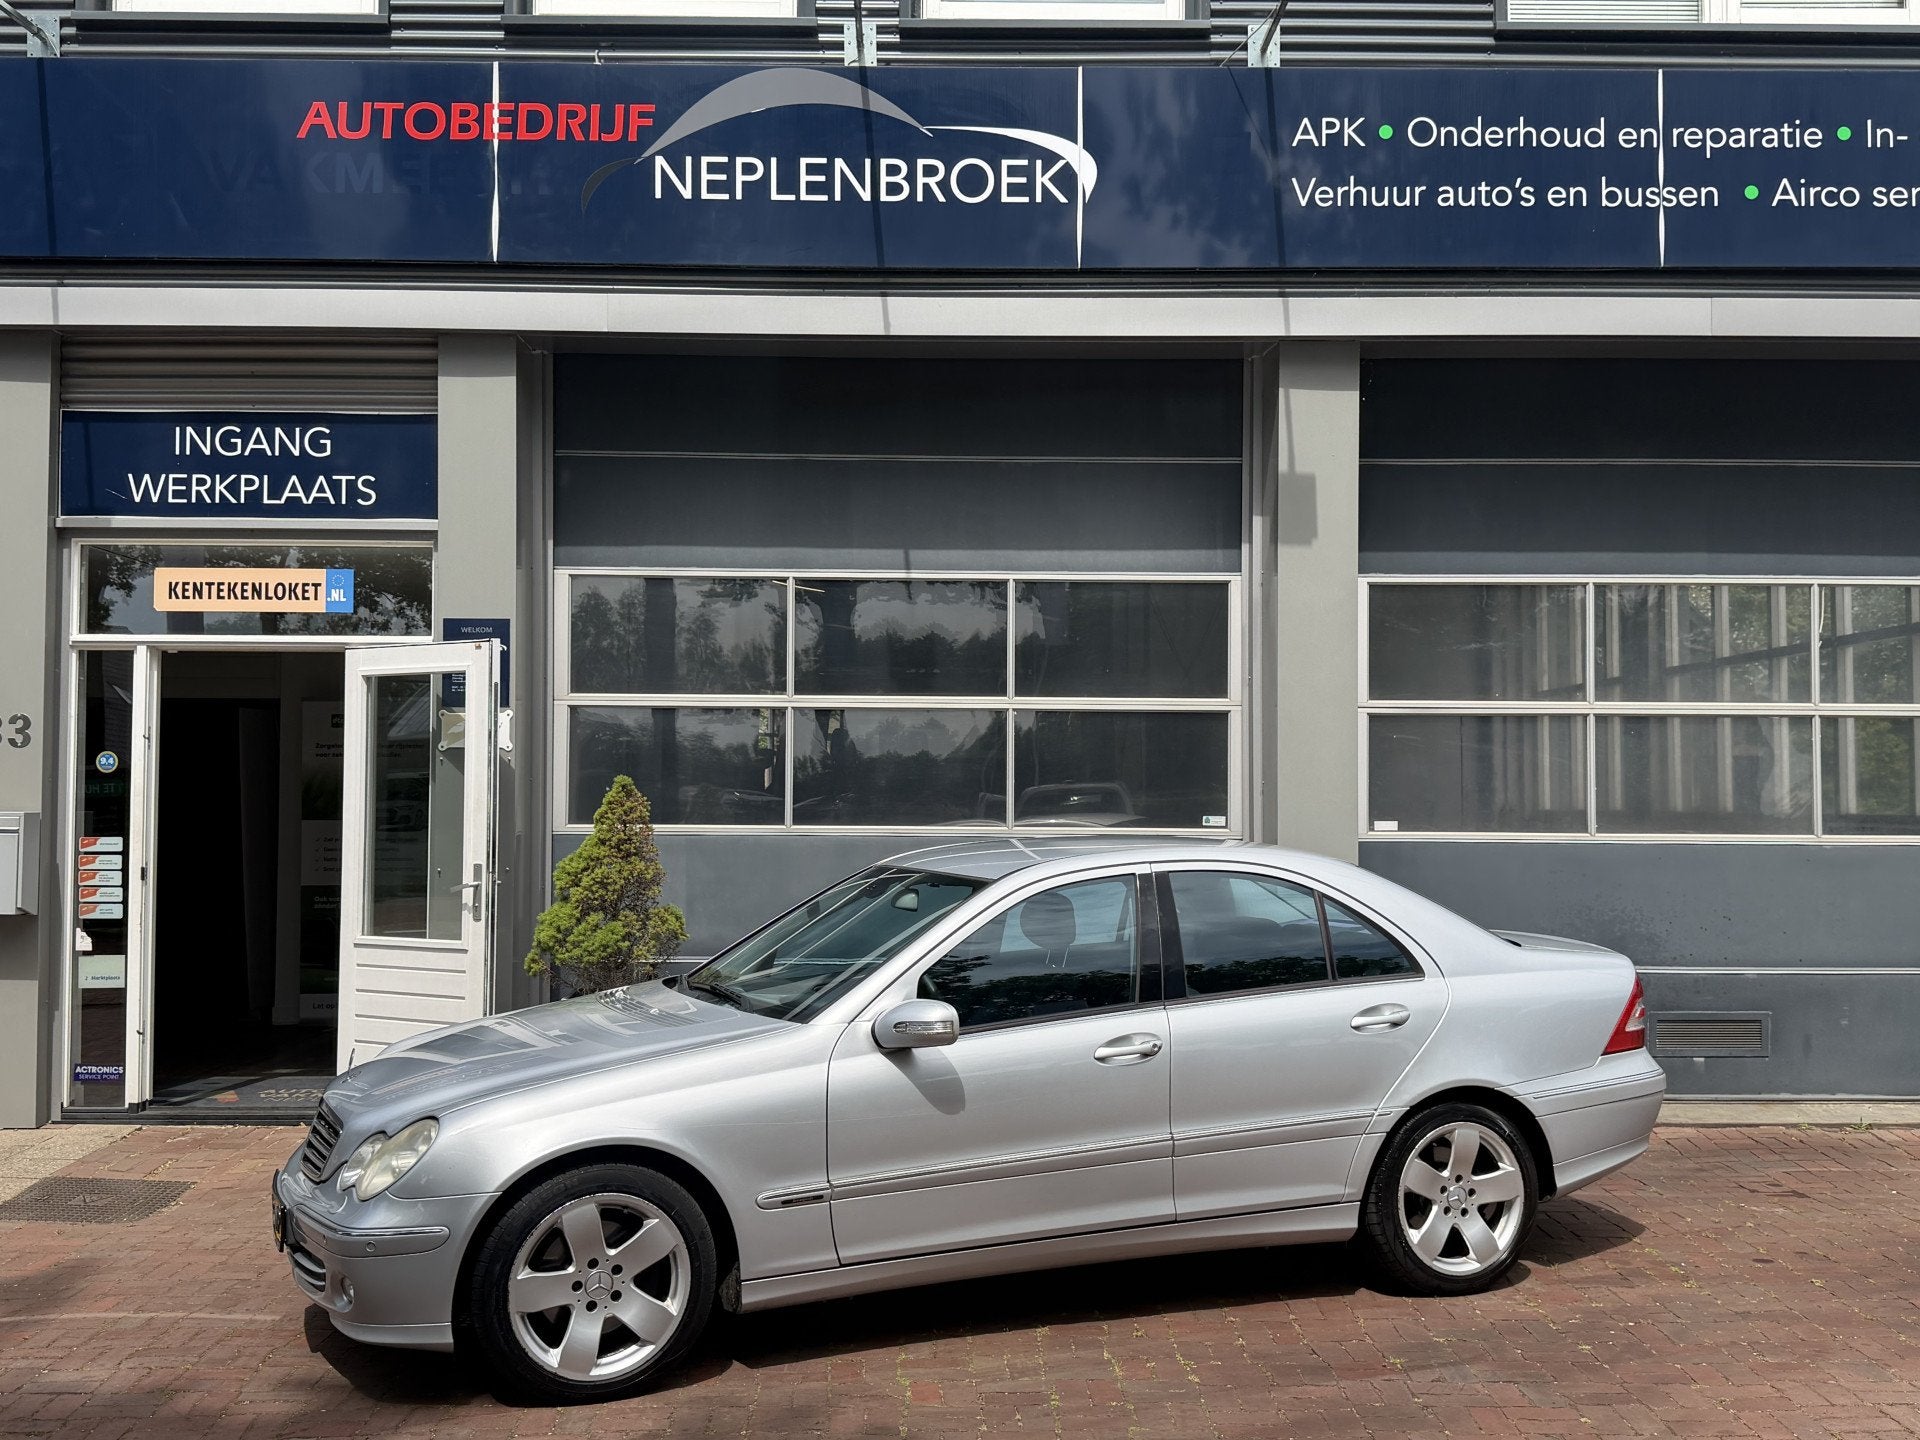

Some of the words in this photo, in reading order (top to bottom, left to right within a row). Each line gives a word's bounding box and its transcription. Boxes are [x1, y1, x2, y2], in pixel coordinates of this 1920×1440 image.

[296, 101, 655, 142] AUTOBEDRIJF
[1291, 117, 1366, 147] APK
[1407, 116, 1605, 148] Onderhoud
[1618, 127, 1658, 148] en
[1672, 119, 1823, 159] reparatie
[1866, 119, 1909, 148] In-
[654, 155, 1069, 204] NEPLENBROEK
[1291, 175, 1426, 207] Verhuur
[1437, 177, 1535, 207] auto's
[1547, 185, 1587, 207] en
[1601, 176, 1719, 208] bussen
[1771, 177, 1861, 207] Airco
[174, 425, 332, 458] INGANG
[127, 473, 377, 506] WERKPLAATS
[168, 581, 322, 601] KENTEKENLOKET
[461, 626, 493, 634] WELKOM
[0, 713, 32, 749] 3
[75, 1066, 124, 1074] ACTRONICS
